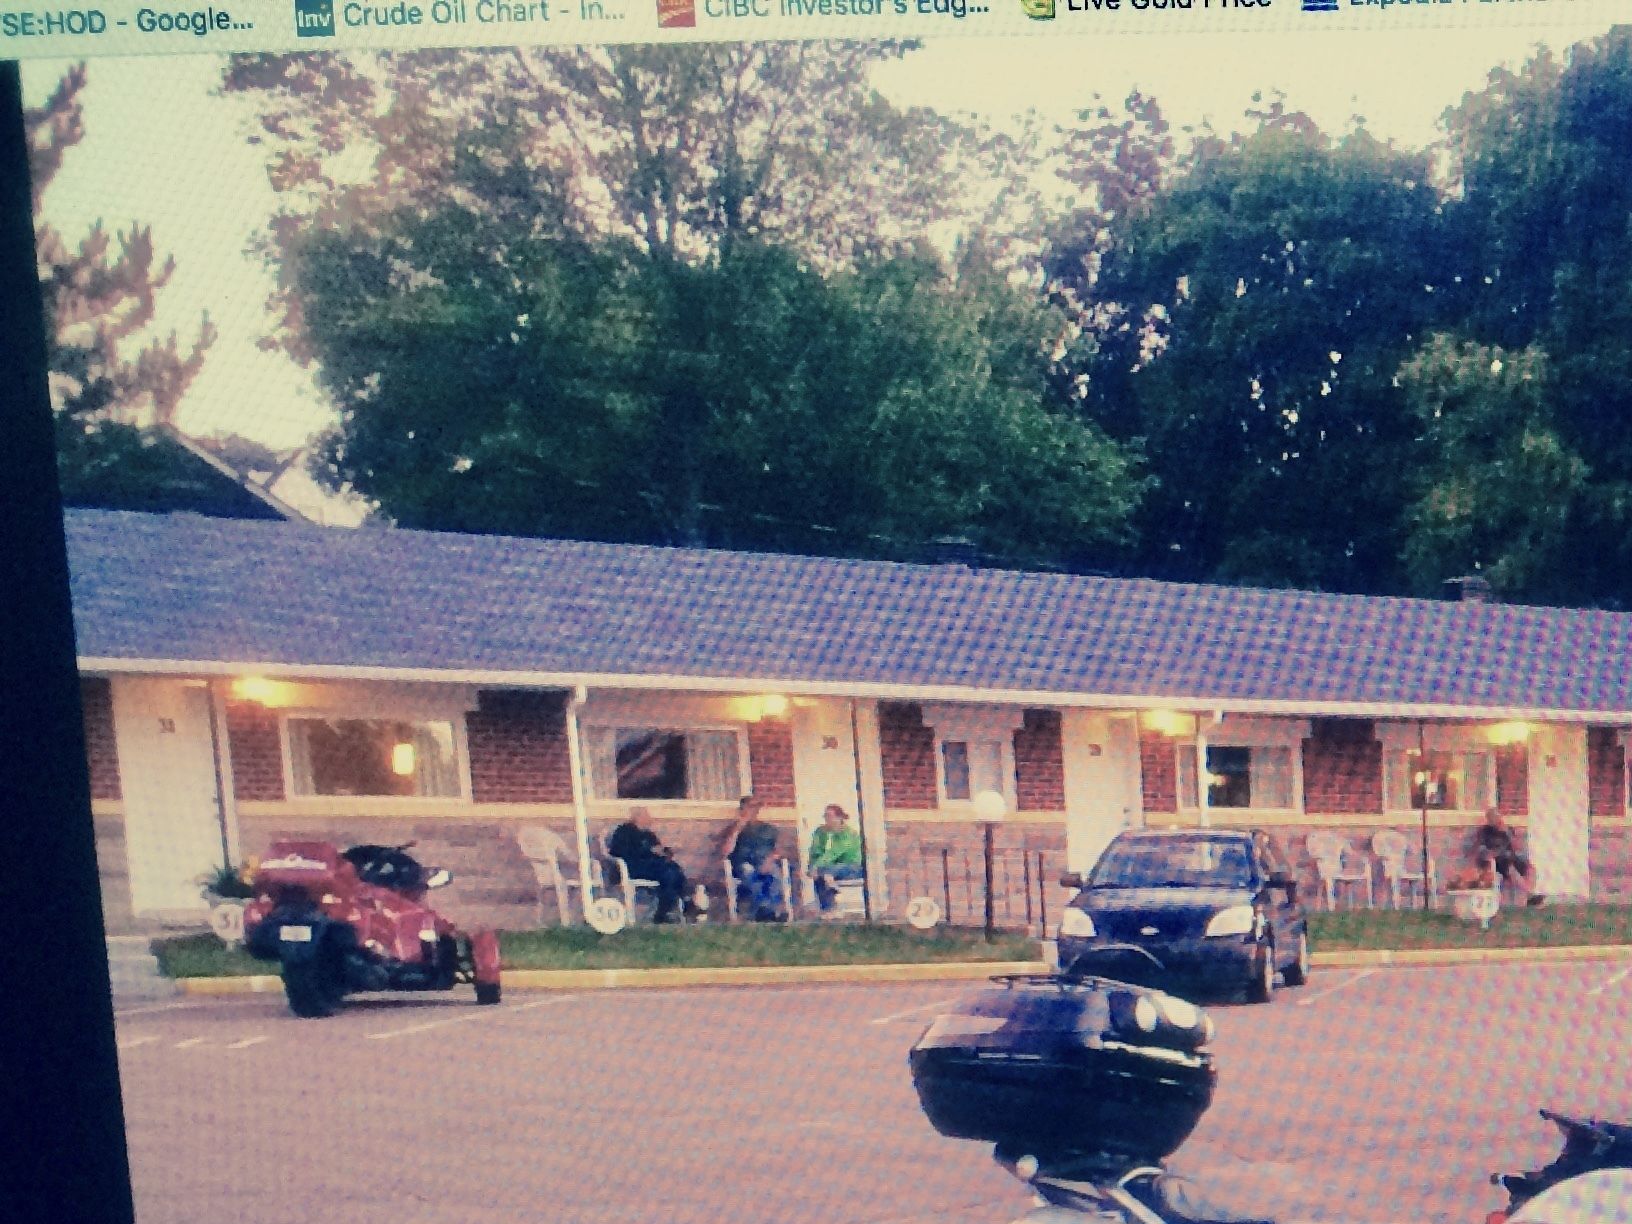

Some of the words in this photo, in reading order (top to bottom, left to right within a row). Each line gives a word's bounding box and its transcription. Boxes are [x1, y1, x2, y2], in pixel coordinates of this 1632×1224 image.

[2, 9, 106, 36] SE:HOD
[136, 6, 254, 37] Google...
[343, 1, 424, 26] Crude
[430, 0, 466, 24] Oil
[475, 0, 551, 23] Chart
[580, 0, 626, 21] In...
[703, 0, 770, 18] CIBC
[780, 0, 909, 17] Investor's
